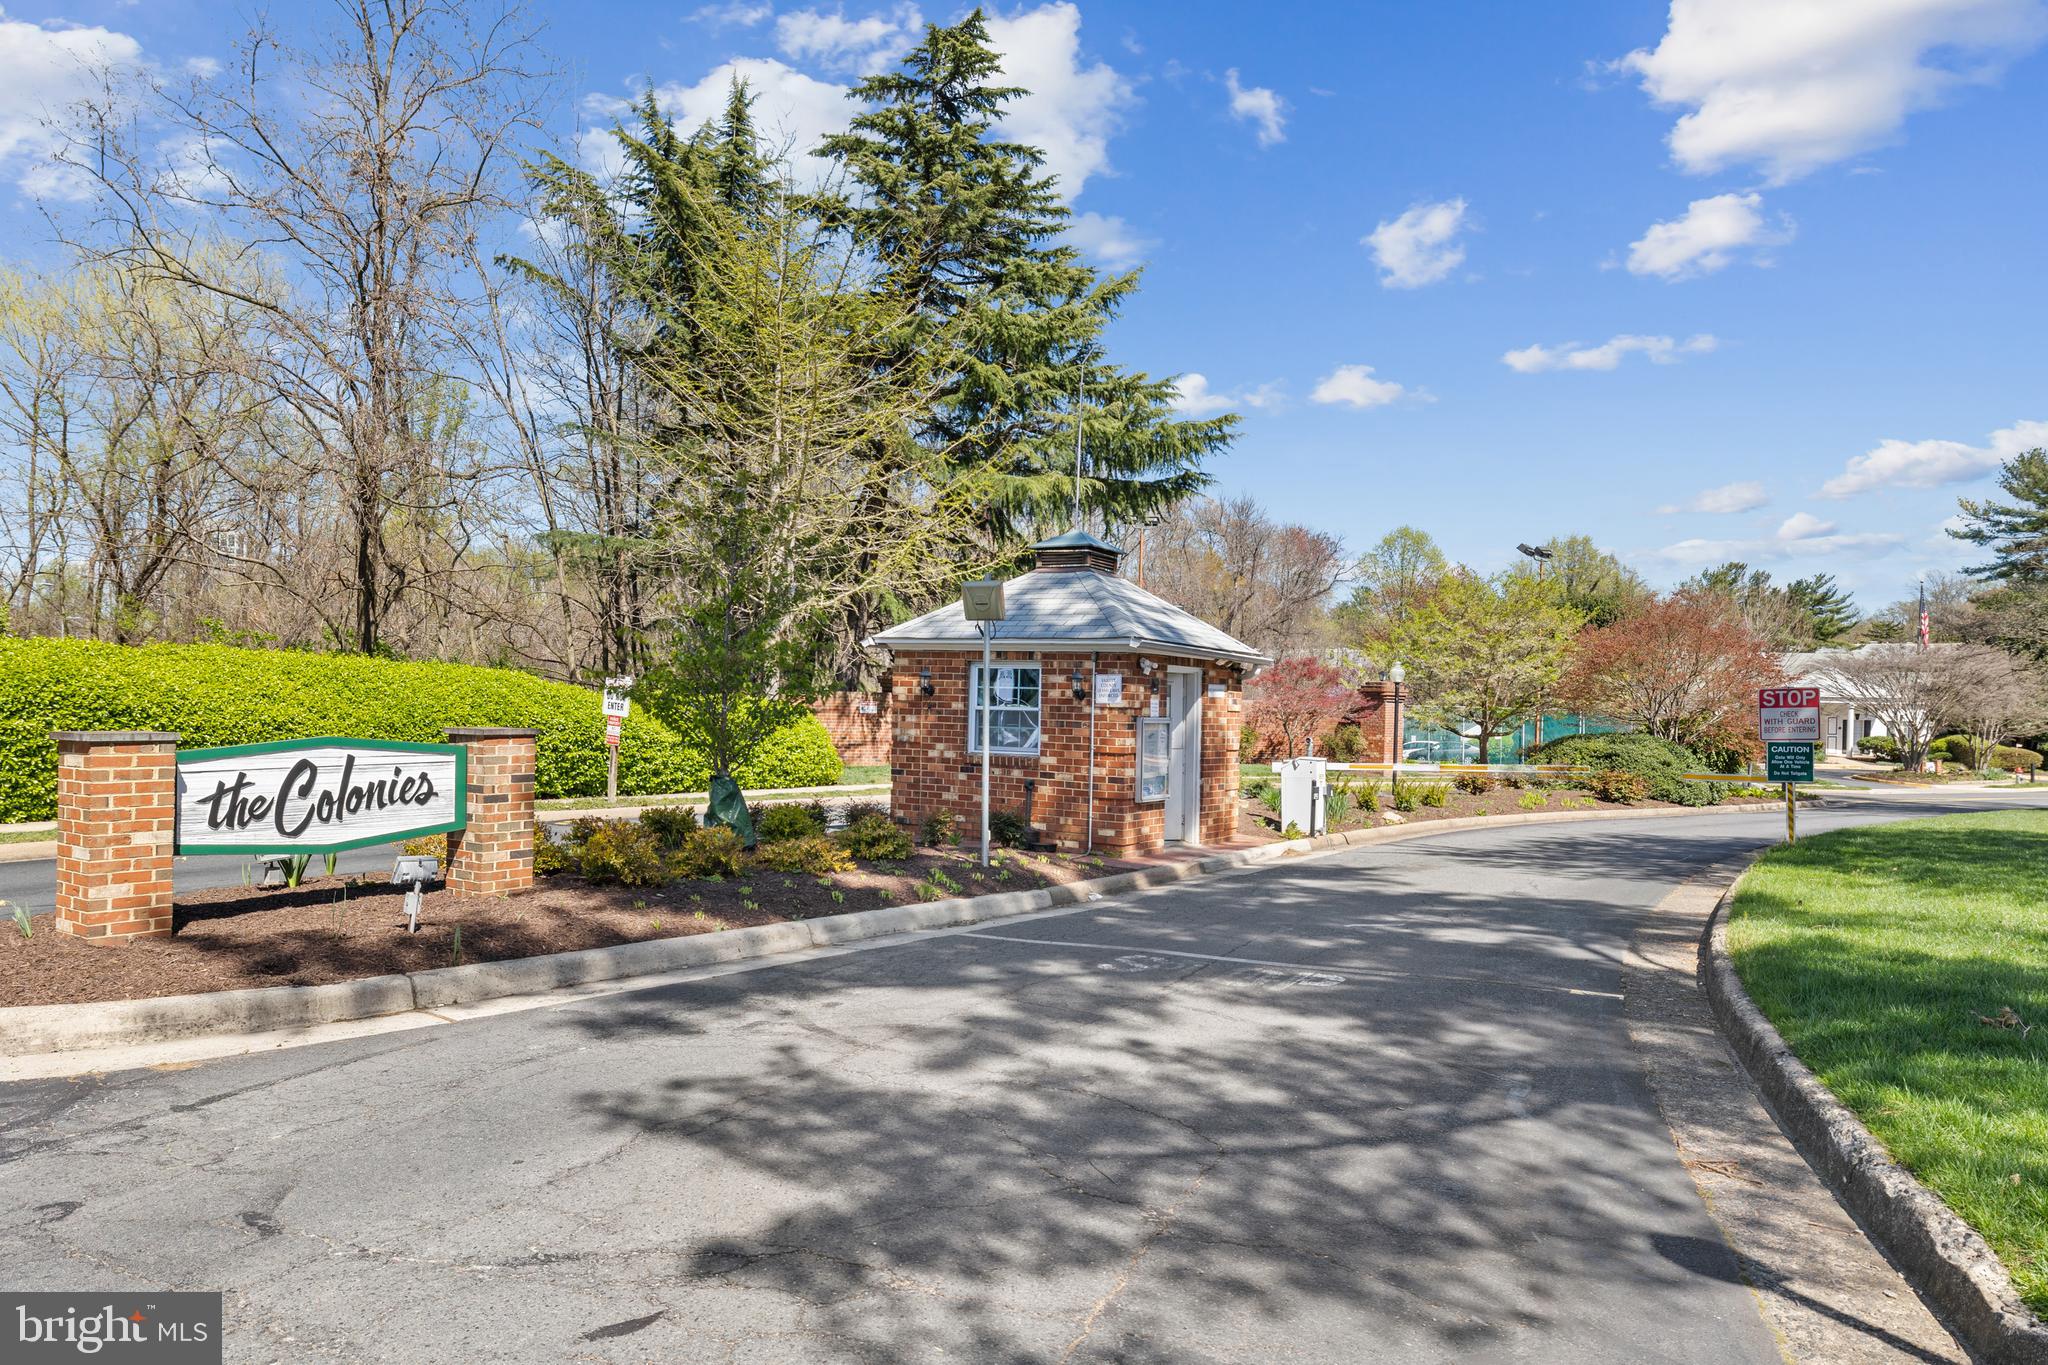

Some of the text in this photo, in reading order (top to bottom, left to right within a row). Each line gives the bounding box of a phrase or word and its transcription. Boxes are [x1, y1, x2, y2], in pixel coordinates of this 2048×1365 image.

[607, 702, 624, 711] ENTER
[1763, 690, 1816, 707] STOP
[194, 753, 439, 839] the Colonies
